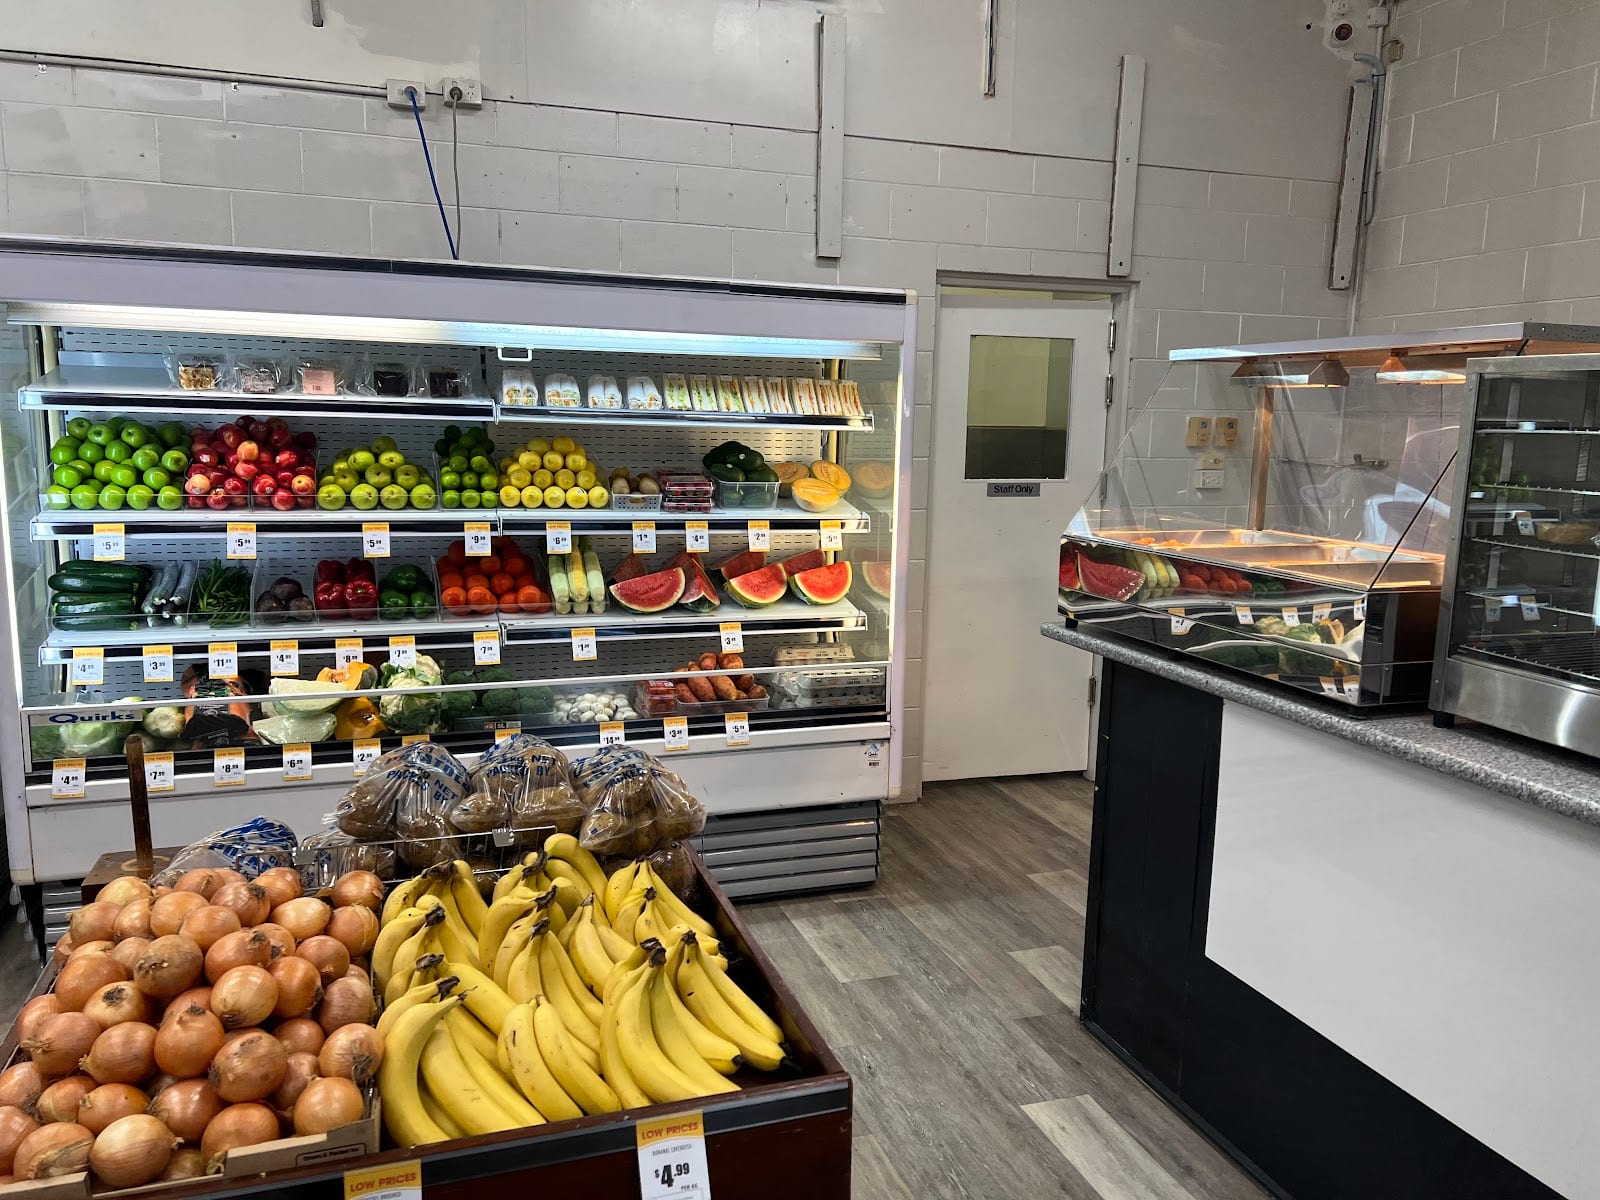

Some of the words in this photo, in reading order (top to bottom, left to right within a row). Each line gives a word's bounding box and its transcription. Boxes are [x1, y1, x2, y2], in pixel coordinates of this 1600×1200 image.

[994, 485, 1014, 493] Staff
[1015, 485, 1034, 494] Only
[48, 711, 135, 723] Quirks
[531, 754, 556, 766] NET
[536, 766, 551, 777] BY
[434, 779, 458, 800] NET
[433, 790, 448, 804] BY
[642, 1129, 663, 1140] LOW
[667, 1122, 698, 1135] PRICES
[350, 1180, 375, 1192] LOW
[379, 1172, 417, 1187] PRICES
[654, 1162, 690, 1188] $4.99
